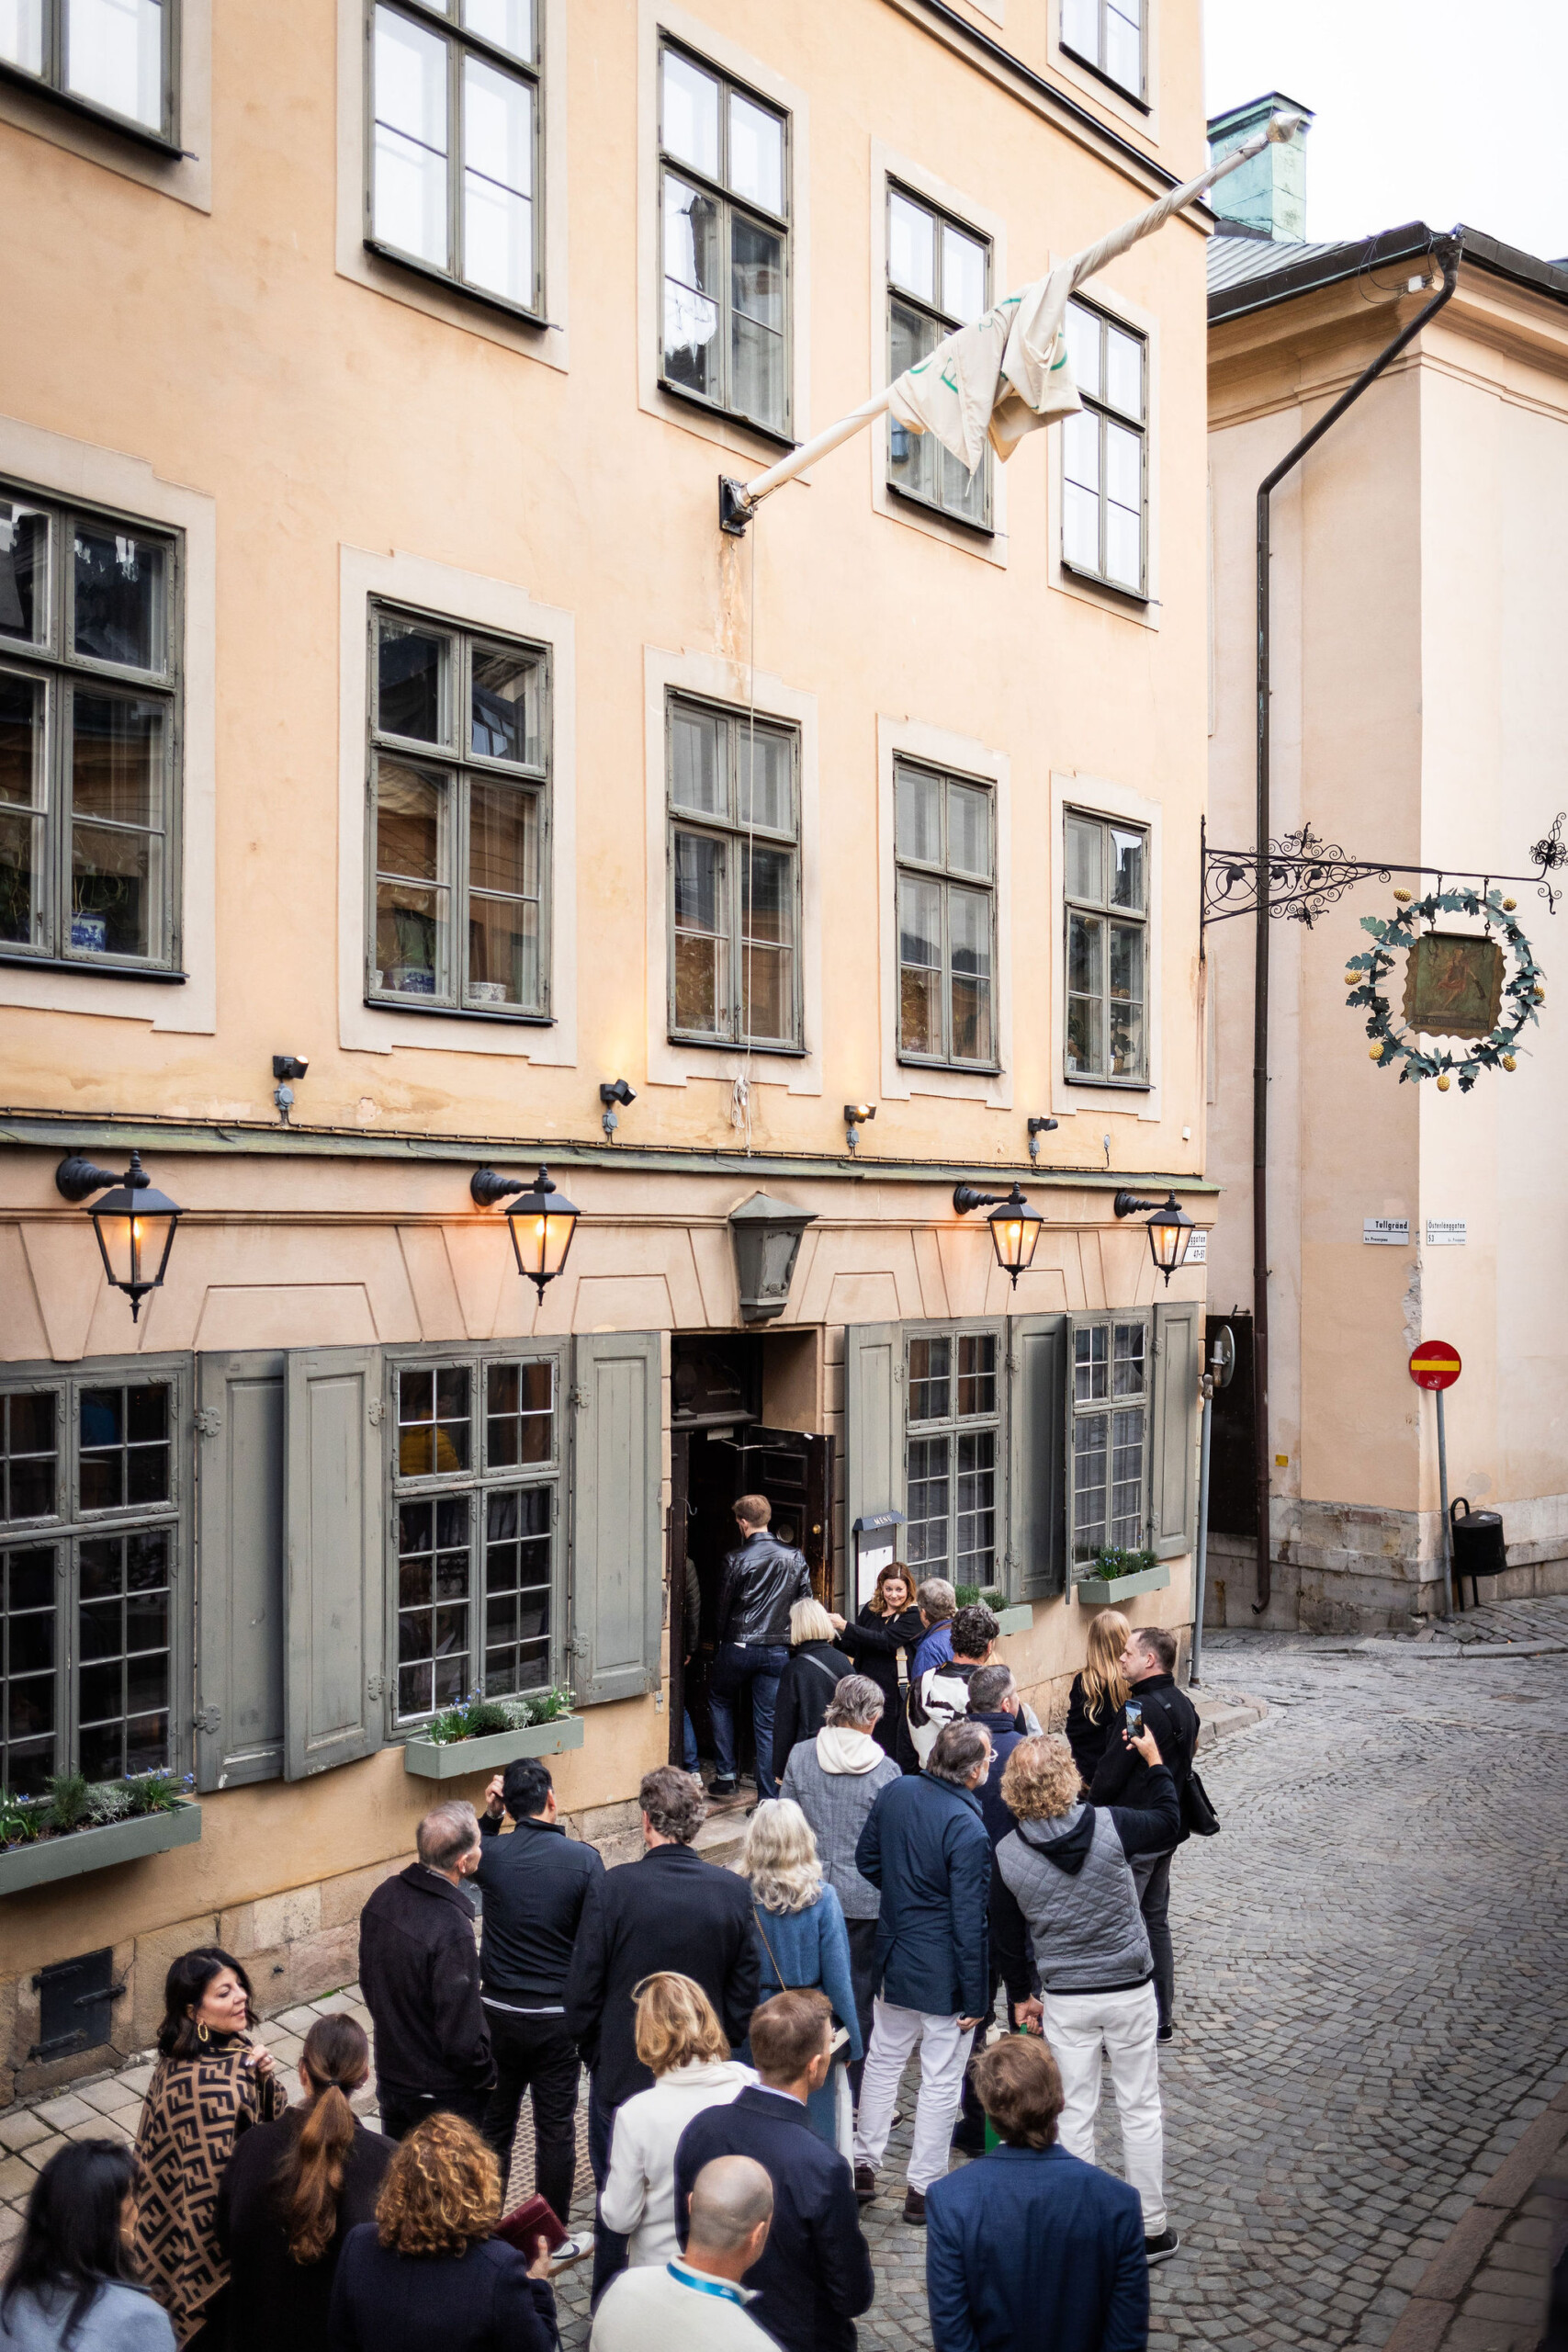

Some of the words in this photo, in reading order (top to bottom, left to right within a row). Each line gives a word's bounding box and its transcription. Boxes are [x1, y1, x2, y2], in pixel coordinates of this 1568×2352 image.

[1375, 1220, 1407, 1230] Tullgränd
[1190, 1236, 1205, 1245] ggatan
[1428, 1234, 1435, 1242] 53
[1193, 1250, 1205, 1259] 47-51
[874, 1515, 892, 1525] MENU
